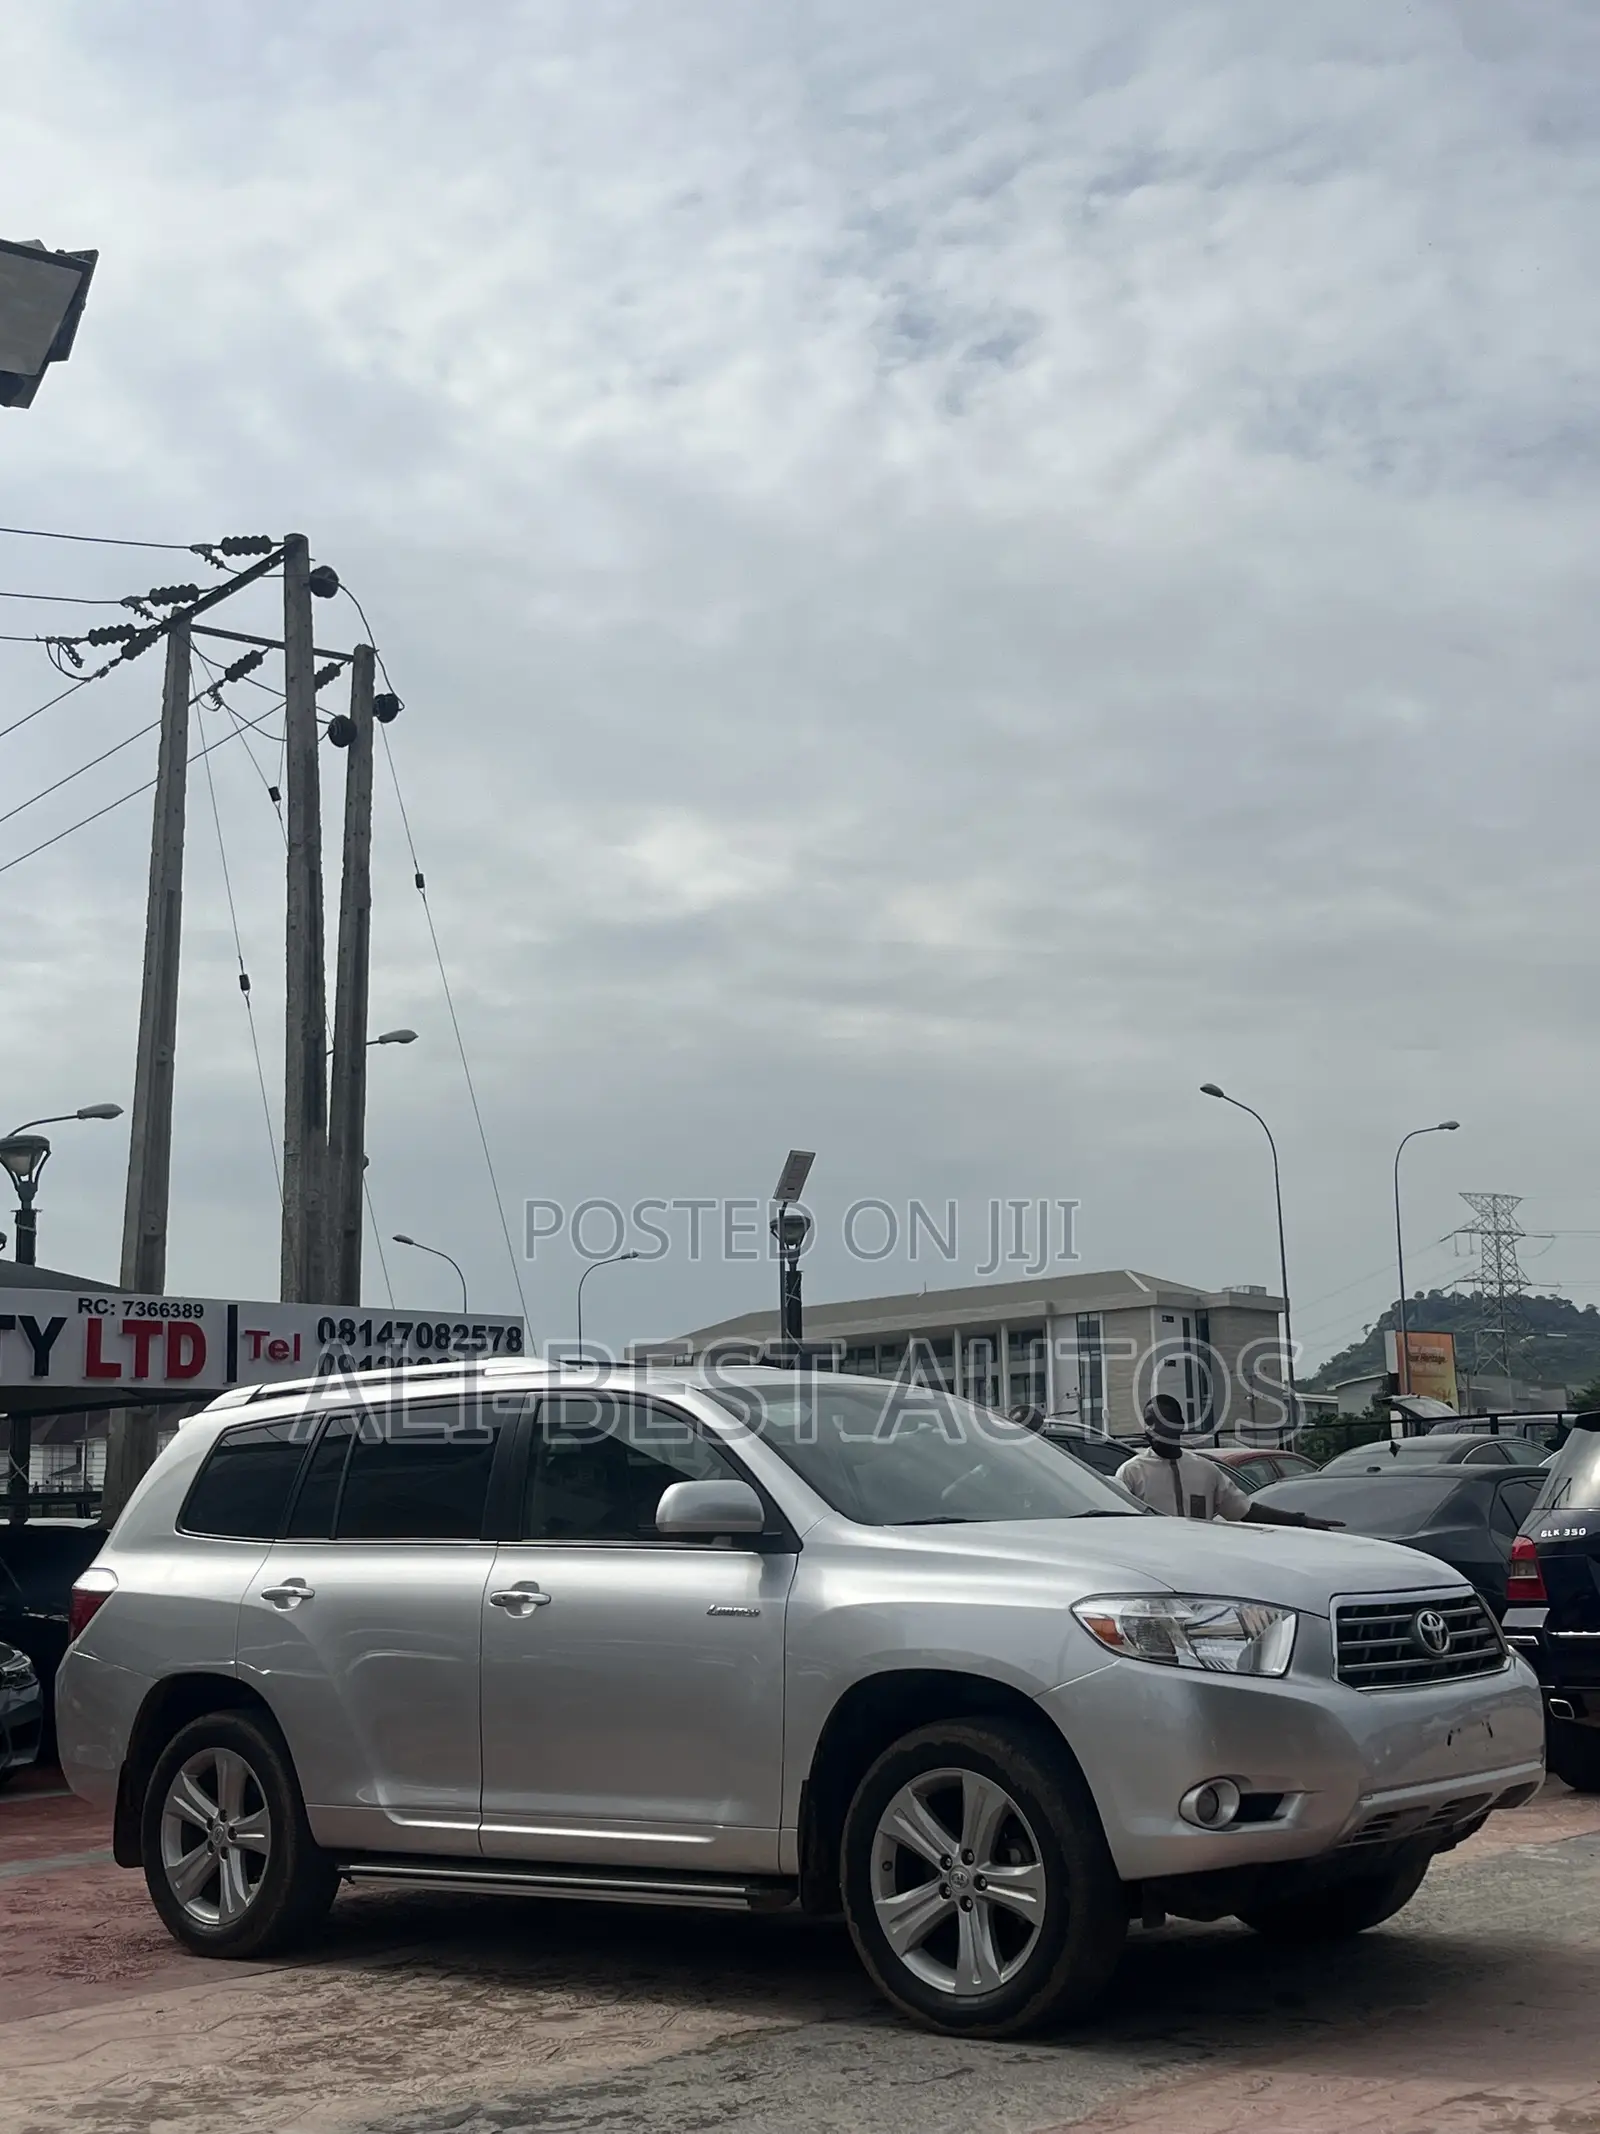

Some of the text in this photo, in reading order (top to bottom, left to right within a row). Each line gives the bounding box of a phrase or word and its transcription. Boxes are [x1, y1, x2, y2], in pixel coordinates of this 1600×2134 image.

[78, 1298, 204, 1318] RC: 7366389
[85, 1317, 207, 1379] LTD
[245, 1316, 522, 1361] Tel 08147082578
[1541, 1528, 1587, 1538] GLK 350
